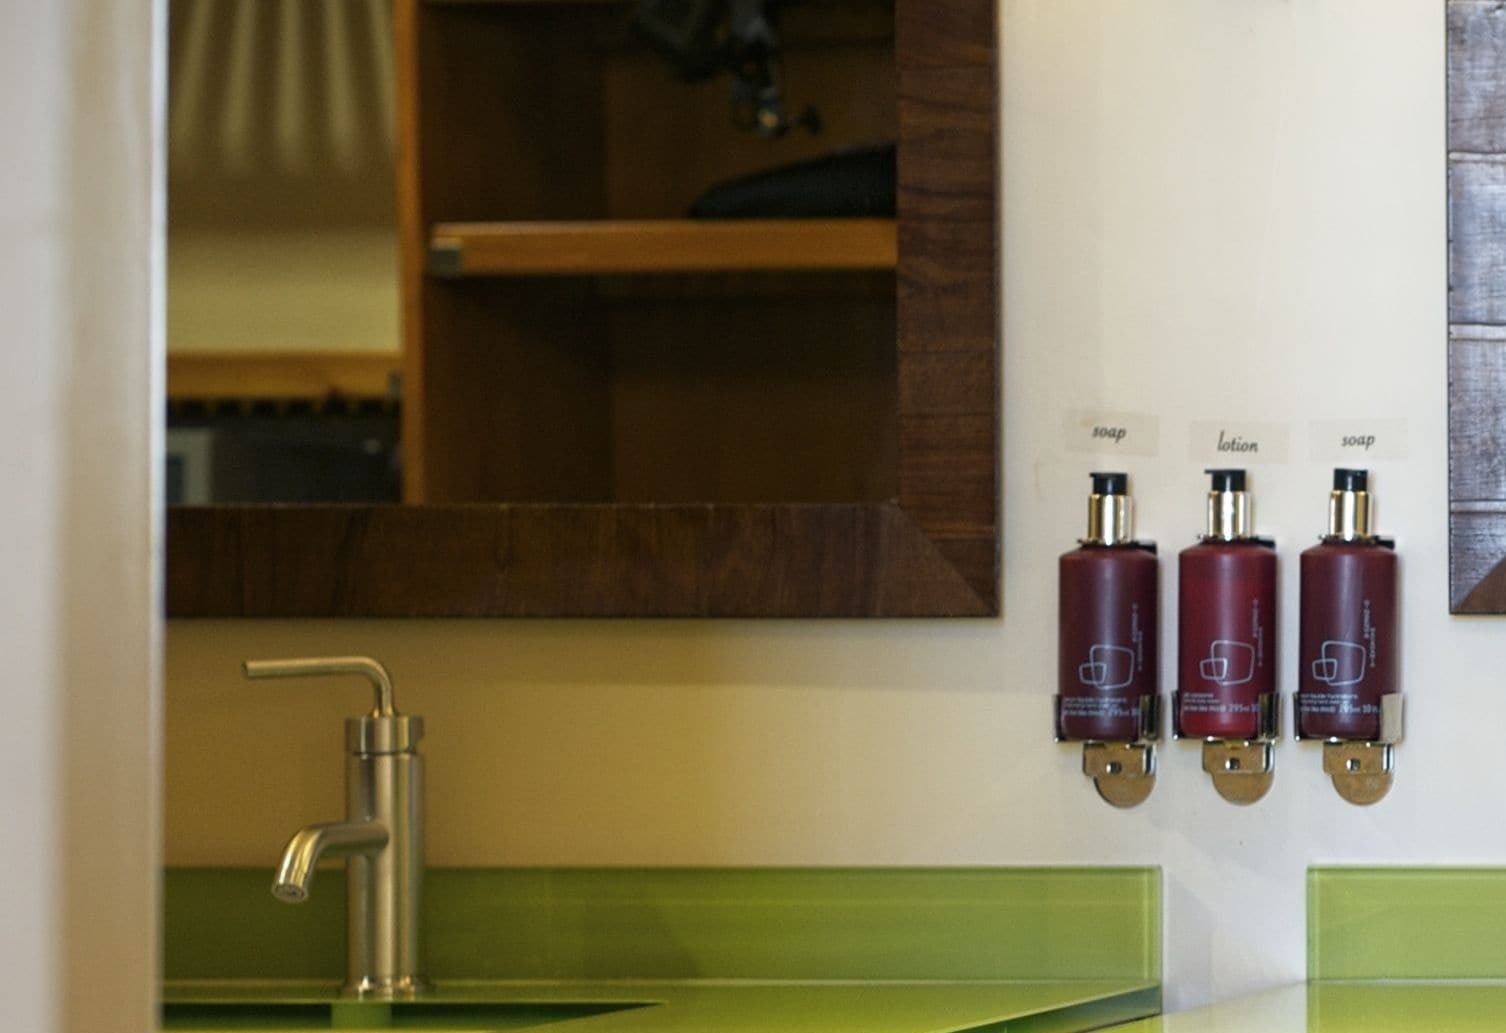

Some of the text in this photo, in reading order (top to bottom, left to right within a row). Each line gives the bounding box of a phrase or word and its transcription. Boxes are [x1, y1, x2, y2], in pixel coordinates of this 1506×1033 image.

[1092, 426, 1127, 443] soap
[1217, 430, 1258, 453] lotion
[1342, 434, 1375, 450] soap
